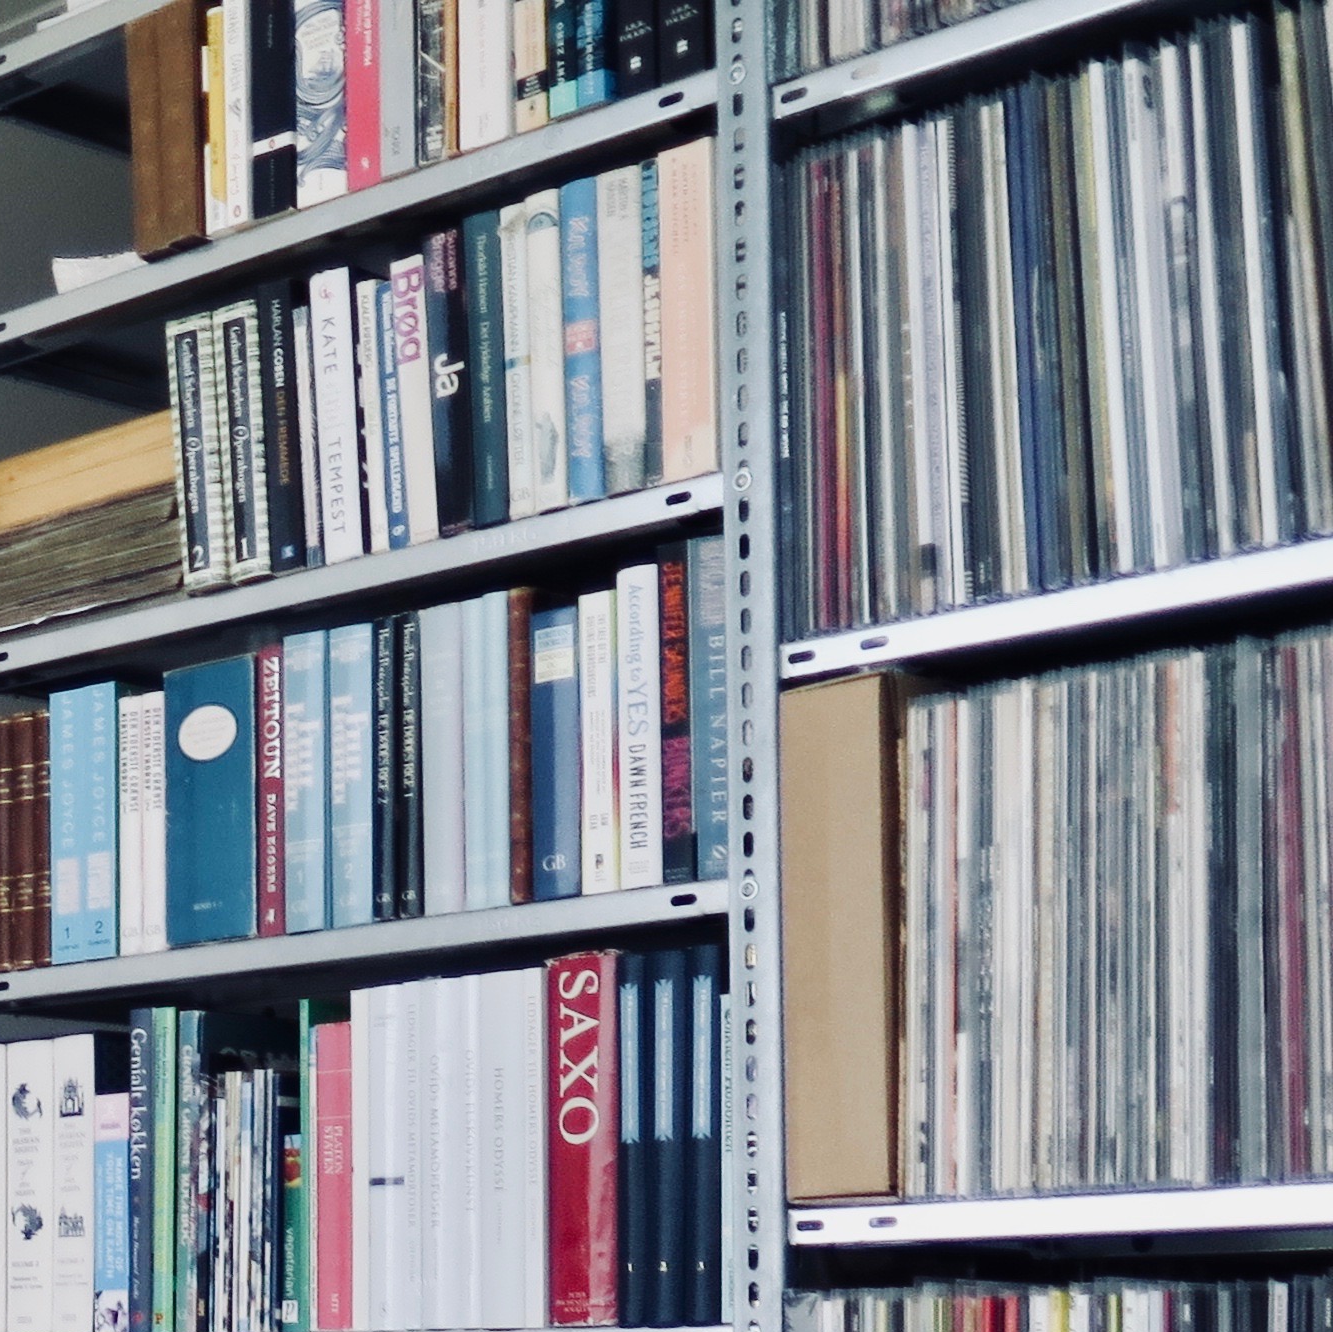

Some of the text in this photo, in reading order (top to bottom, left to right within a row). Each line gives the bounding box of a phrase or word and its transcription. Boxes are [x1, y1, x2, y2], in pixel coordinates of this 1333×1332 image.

[555, 22, 565, 55] ZERO
[430, 232, 446, 294] Brøgger
[446, 228, 458, 290] Suzanne
[475, 234, 489, 277] Thorkild
[271, 299, 284, 347] HARLAN
[477, 278, 490, 314] Hansen
[507, 284, 521, 353] KAMPMANN
[321, 317, 336, 375] KATE
[479, 320, 491, 340] Det
[274, 347, 285, 388] COBEN
[434, 352, 465, 399] Ja
[482, 386, 494, 424] Arabien
[185, 436, 203, 515] Operabogen
[232, 424, 250, 503] Operabogen
[277, 418, 291, 486] FREMMEDE
[326, 436, 347, 534] TEMPEST
[191, 545, 204, 570] 2
[239, 536, 247, 559] 1
[662, 563, 687, 725] JENNIFER SAUNDERS
[708, 635, 725, 700] BILL
[61, 695, 75, 771] JAMES
[92, 689, 106, 764] JAMES
[625, 584, 649, 850] According to YES DAWN FRENCH
[262, 655, 280, 893] ZEITOUN DAVE EGGERS
[711, 713, 727, 825] NAPIER
[61, 779, 75, 849] JOYCE
[92, 772, 106, 844] JOYCE
[542, 853, 567, 872] GB
[63, 927, 69, 940] 1
[94, 920, 103, 935] 2
[406, 1003, 416, 1063] LEDSAGER
[526, 996, 537, 1058] LEDSAGER
[558, 969, 600, 1146] SAXO
[464, 1049, 474, 1097] OVIDS
[493, 1067, 505, 1132] HOMERS
[527, 1061, 537, 1079] TIL
[130, 1027, 148, 1180] Genialt køkken
[407, 1089, 416, 1127] OVIDS
[527, 1084, 538, 1136] HOMERS
[323, 1125, 333, 1175] STATEN
[333, 1124, 343, 1174] PLATON
[429, 1054, 441, 1229] OVIDS METAMORFOSER
[105, 1188, 115, 1216] TIME
[407, 1131, 416, 1229] METAMORFOSER
[105, 1218, 115, 1236] ON
[115, 1157, 125, 1271] MAKE THE MOST OF
[106, 1238, 116, 1279] EARTH
[283, 1227, 295, 1298] vegetarian
